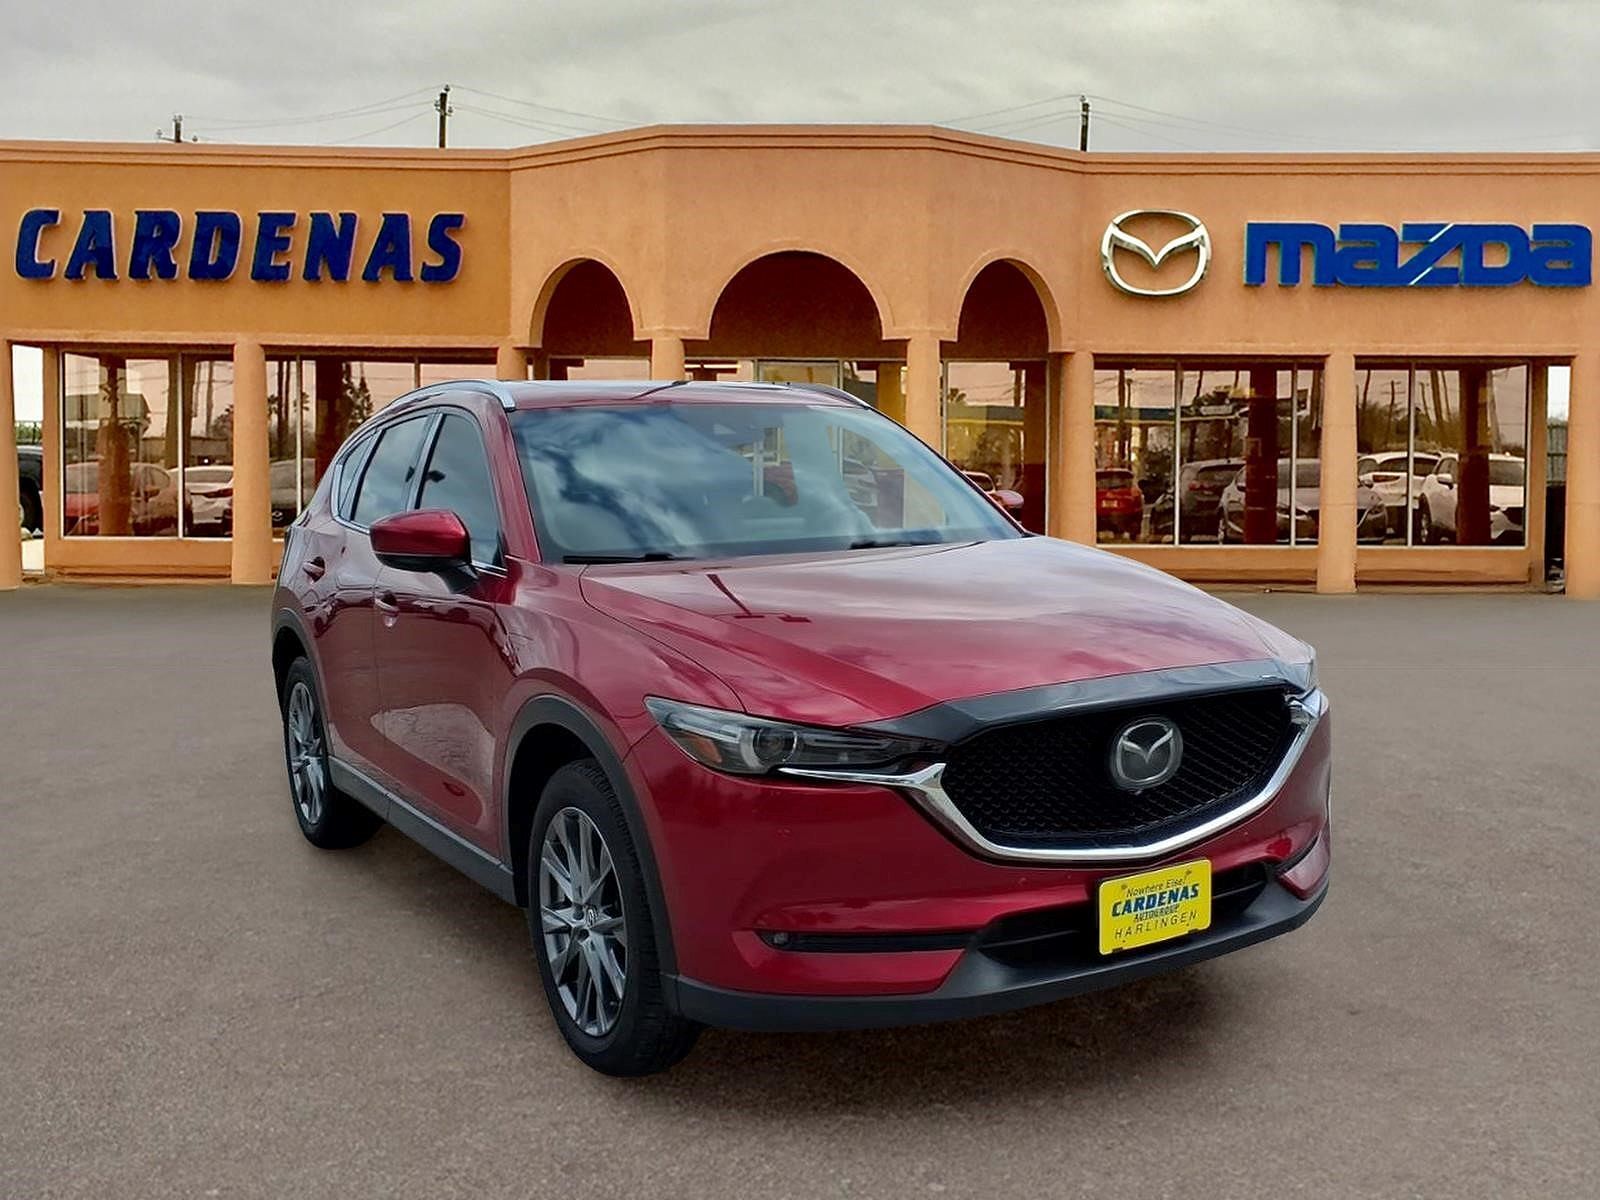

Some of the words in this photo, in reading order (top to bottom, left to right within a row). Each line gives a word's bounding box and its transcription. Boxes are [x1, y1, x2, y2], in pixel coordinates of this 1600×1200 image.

[15, 208, 467, 282] CARDENAS
[1111, 883, 1200, 917] CARDENAS
[1126, 883, 1165, 898] Nowhere
[1114, 910, 1197, 939] HARLINGEN
